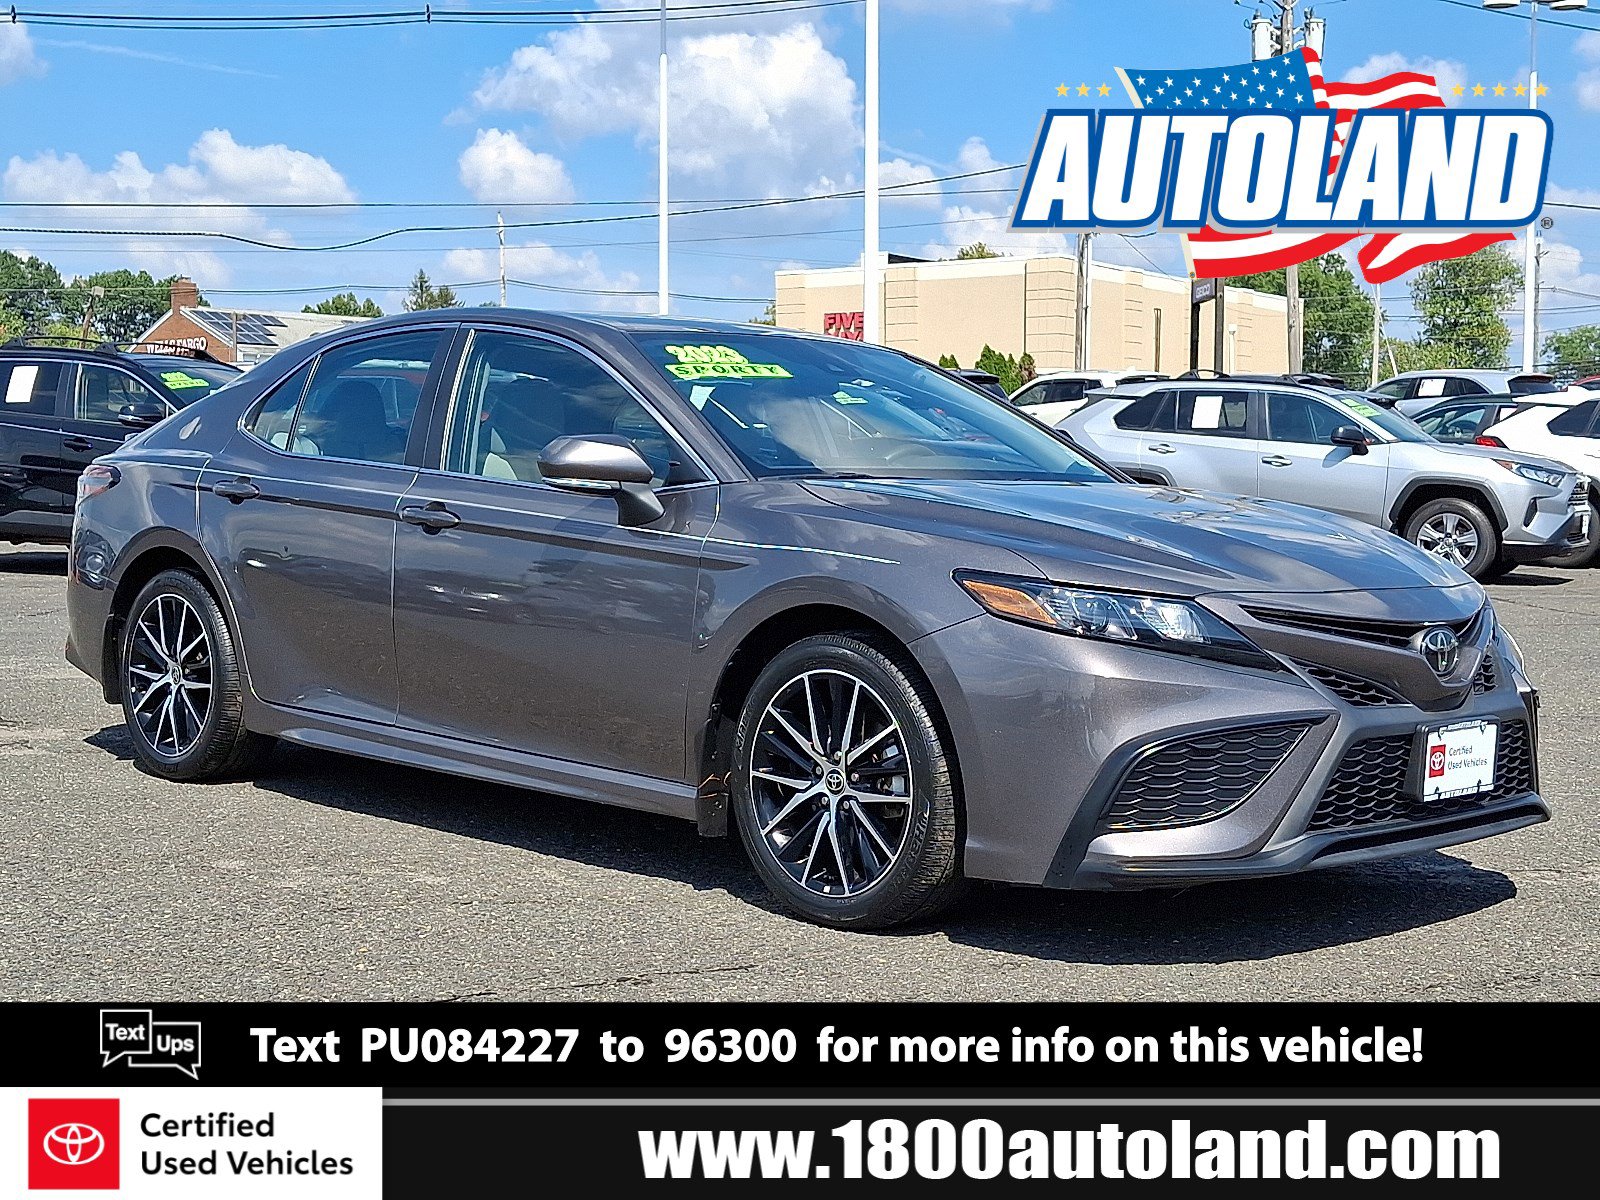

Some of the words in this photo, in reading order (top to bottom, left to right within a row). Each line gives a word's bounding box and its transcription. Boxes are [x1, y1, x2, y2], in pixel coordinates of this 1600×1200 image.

[824, 312, 864, 330] FIVE
[179, 336, 208, 351] FARGO
[674, 364, 780, 376] SPORTY
[1448, 745, 1473, 756] Certified
[1447, 760, 1463, 770] Used
[1464, 758, 1488, 768] Vehicles
